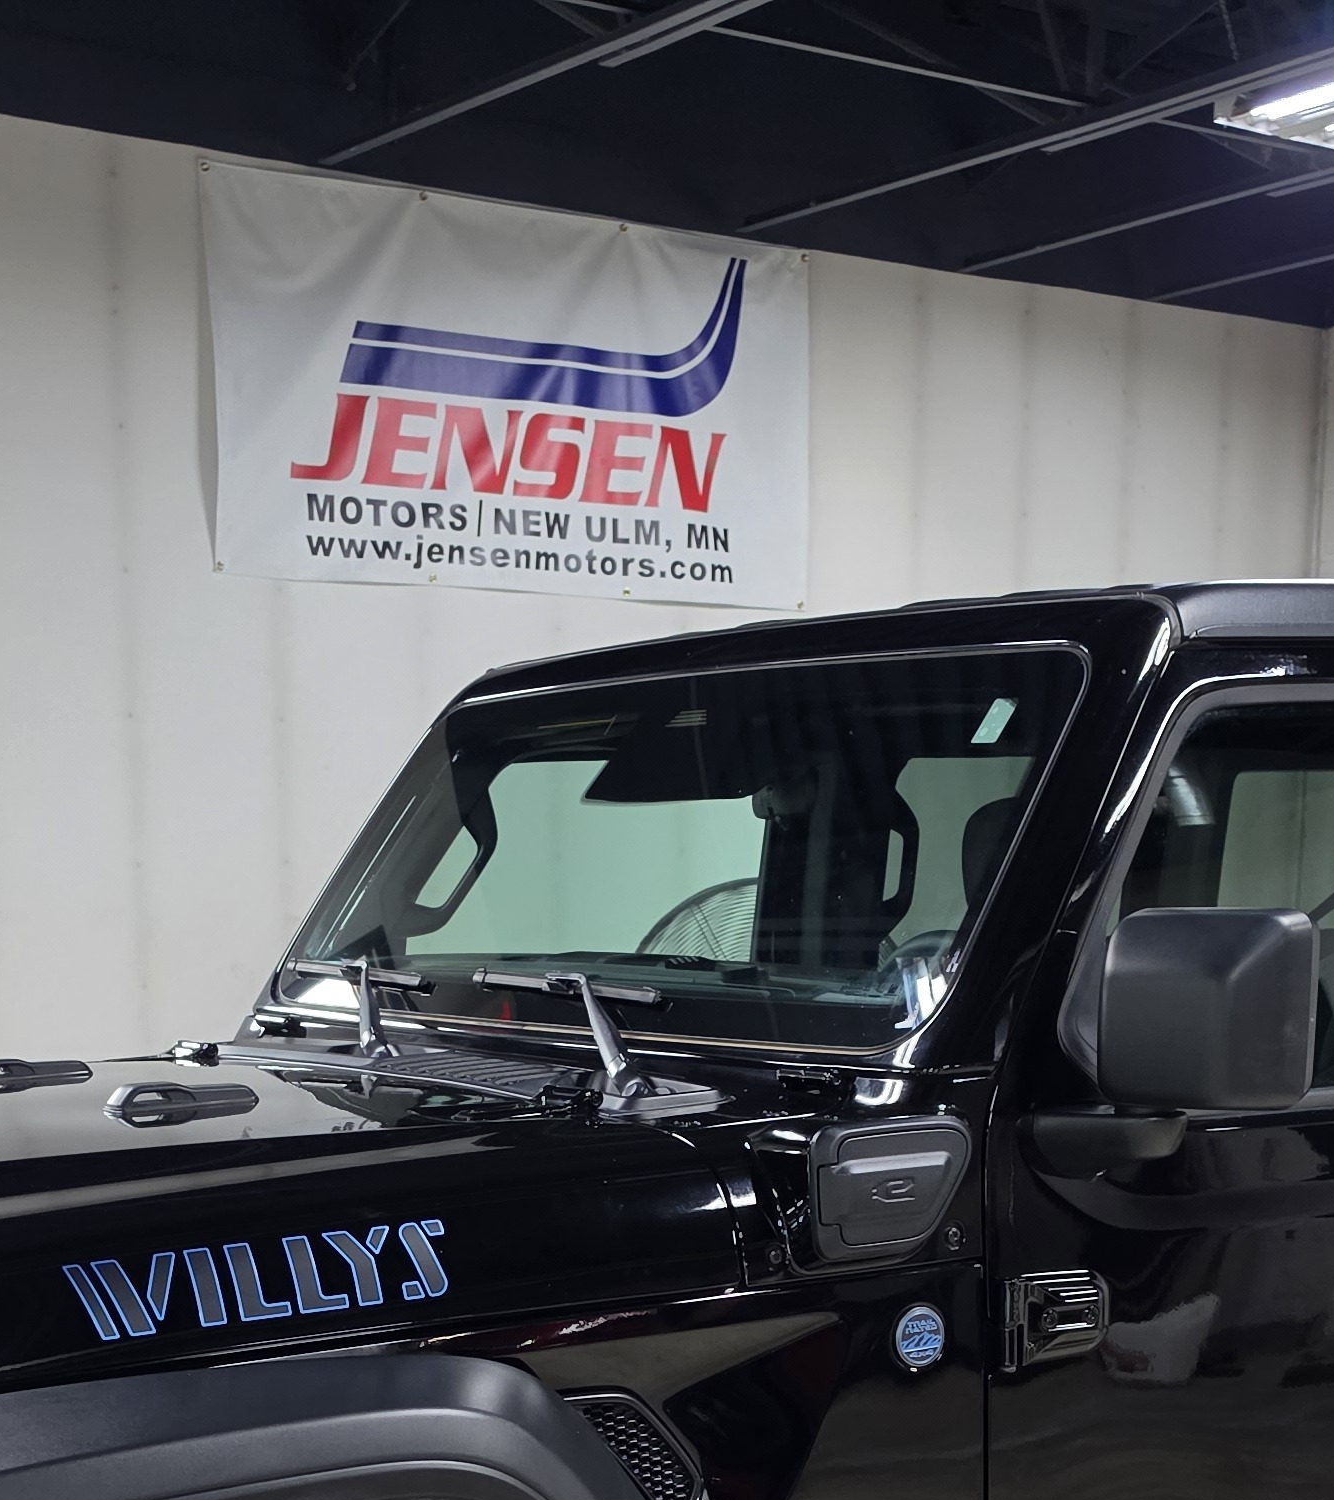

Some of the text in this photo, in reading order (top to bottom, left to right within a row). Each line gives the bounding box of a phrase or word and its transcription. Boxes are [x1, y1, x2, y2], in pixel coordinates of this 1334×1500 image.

[290, 393, 727, 513] JENSEN
[305, 534, 734, 584] www.jensenmotors.com
[306, 493, 730, 553] MOTORS NEW ULM, MN
[61, 1219, 449, 1341] WILLYS
